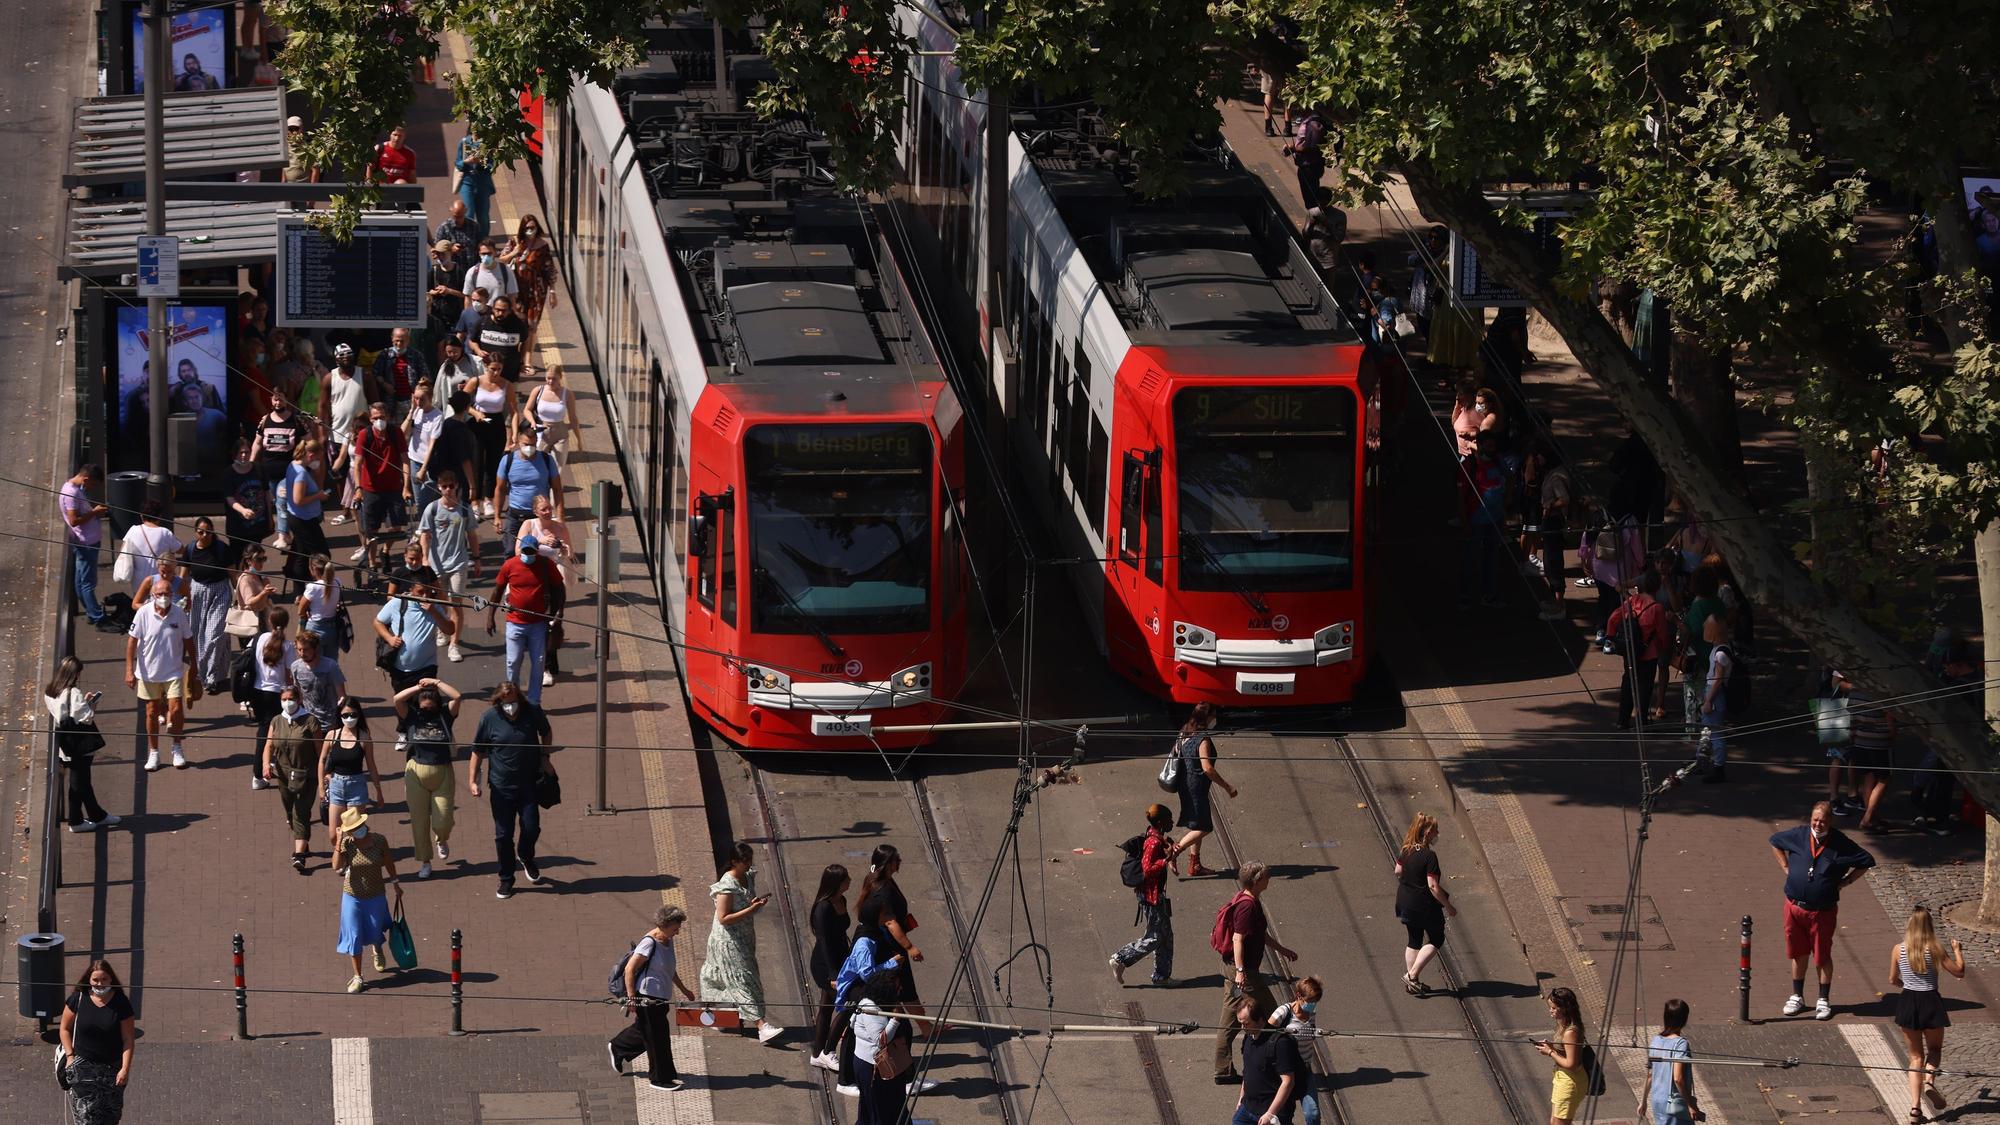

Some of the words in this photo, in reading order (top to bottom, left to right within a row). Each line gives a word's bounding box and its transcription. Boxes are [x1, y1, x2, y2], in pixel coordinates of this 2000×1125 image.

[1197, 394, 1210, 419] 9
[1255, 394, 1303, 419] Sülz
[797, 433, 910, 456] Bensberg
[1252, 683, 1284, 692] 4098
